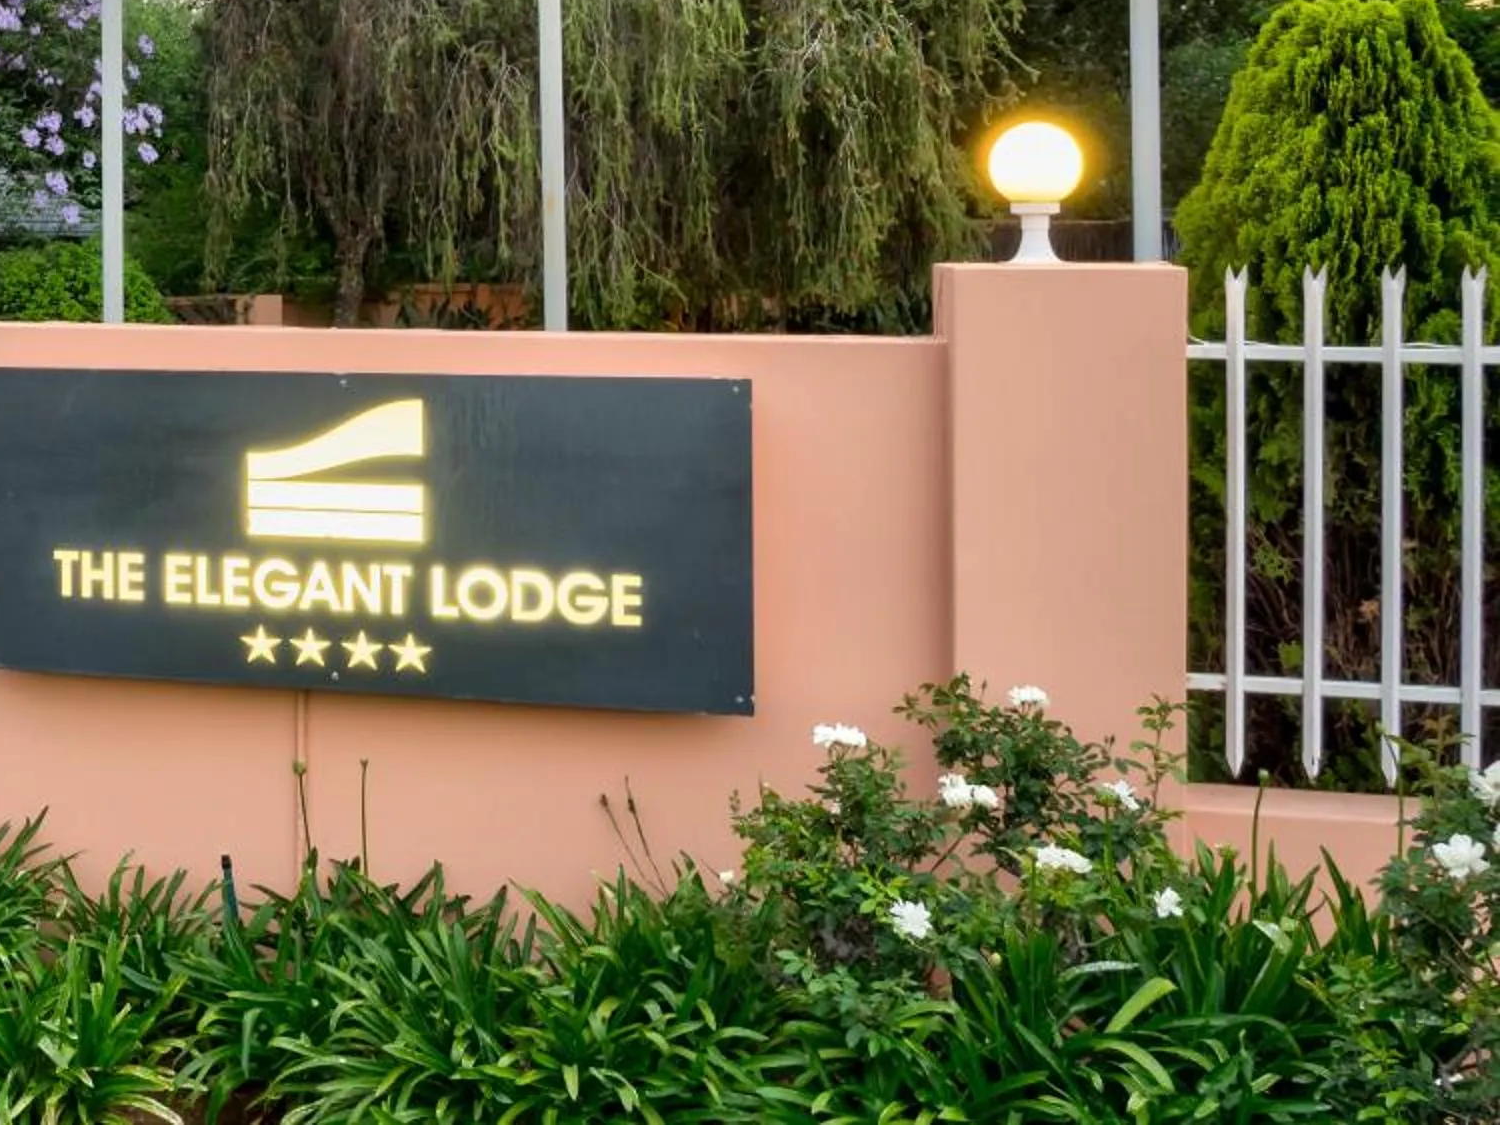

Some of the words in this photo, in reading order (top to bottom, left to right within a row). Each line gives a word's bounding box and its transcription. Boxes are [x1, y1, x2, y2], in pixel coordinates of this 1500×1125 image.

[53, 549, 146, 603] THE
[162, 555, 415, 617] ELEGANT
[429, 566, 644, 628] LODGE
